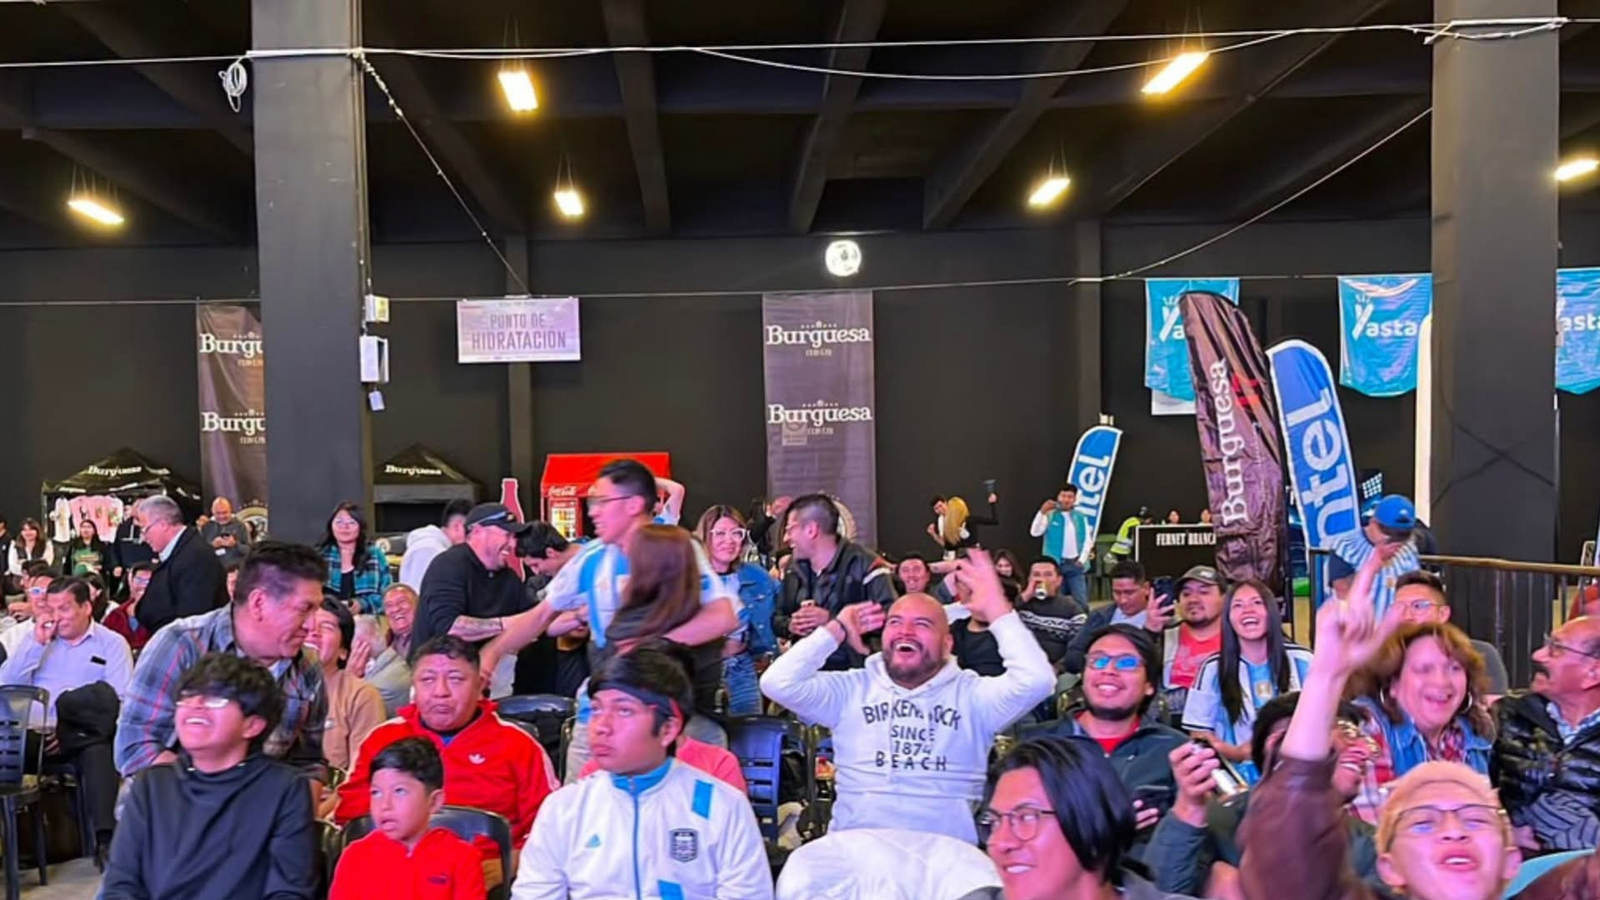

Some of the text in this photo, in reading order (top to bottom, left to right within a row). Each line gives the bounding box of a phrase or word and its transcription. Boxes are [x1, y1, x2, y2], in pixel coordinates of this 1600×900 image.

[490, 313, 546, 329] PUNTO DE
[1352, 303, 1418, 341] Yasta
[766, 325, 871, 348] Burguesa
[768, 404, 873, 427] Burguesa
[1209, 357, 1248, 526] Burguesa
[1156, 533, 1187, 546] FERNET
[891, 725, 935, 742] SINCE
[895, 740, 932, 756] 1874
[875, 751, 947, 771] BEACH
